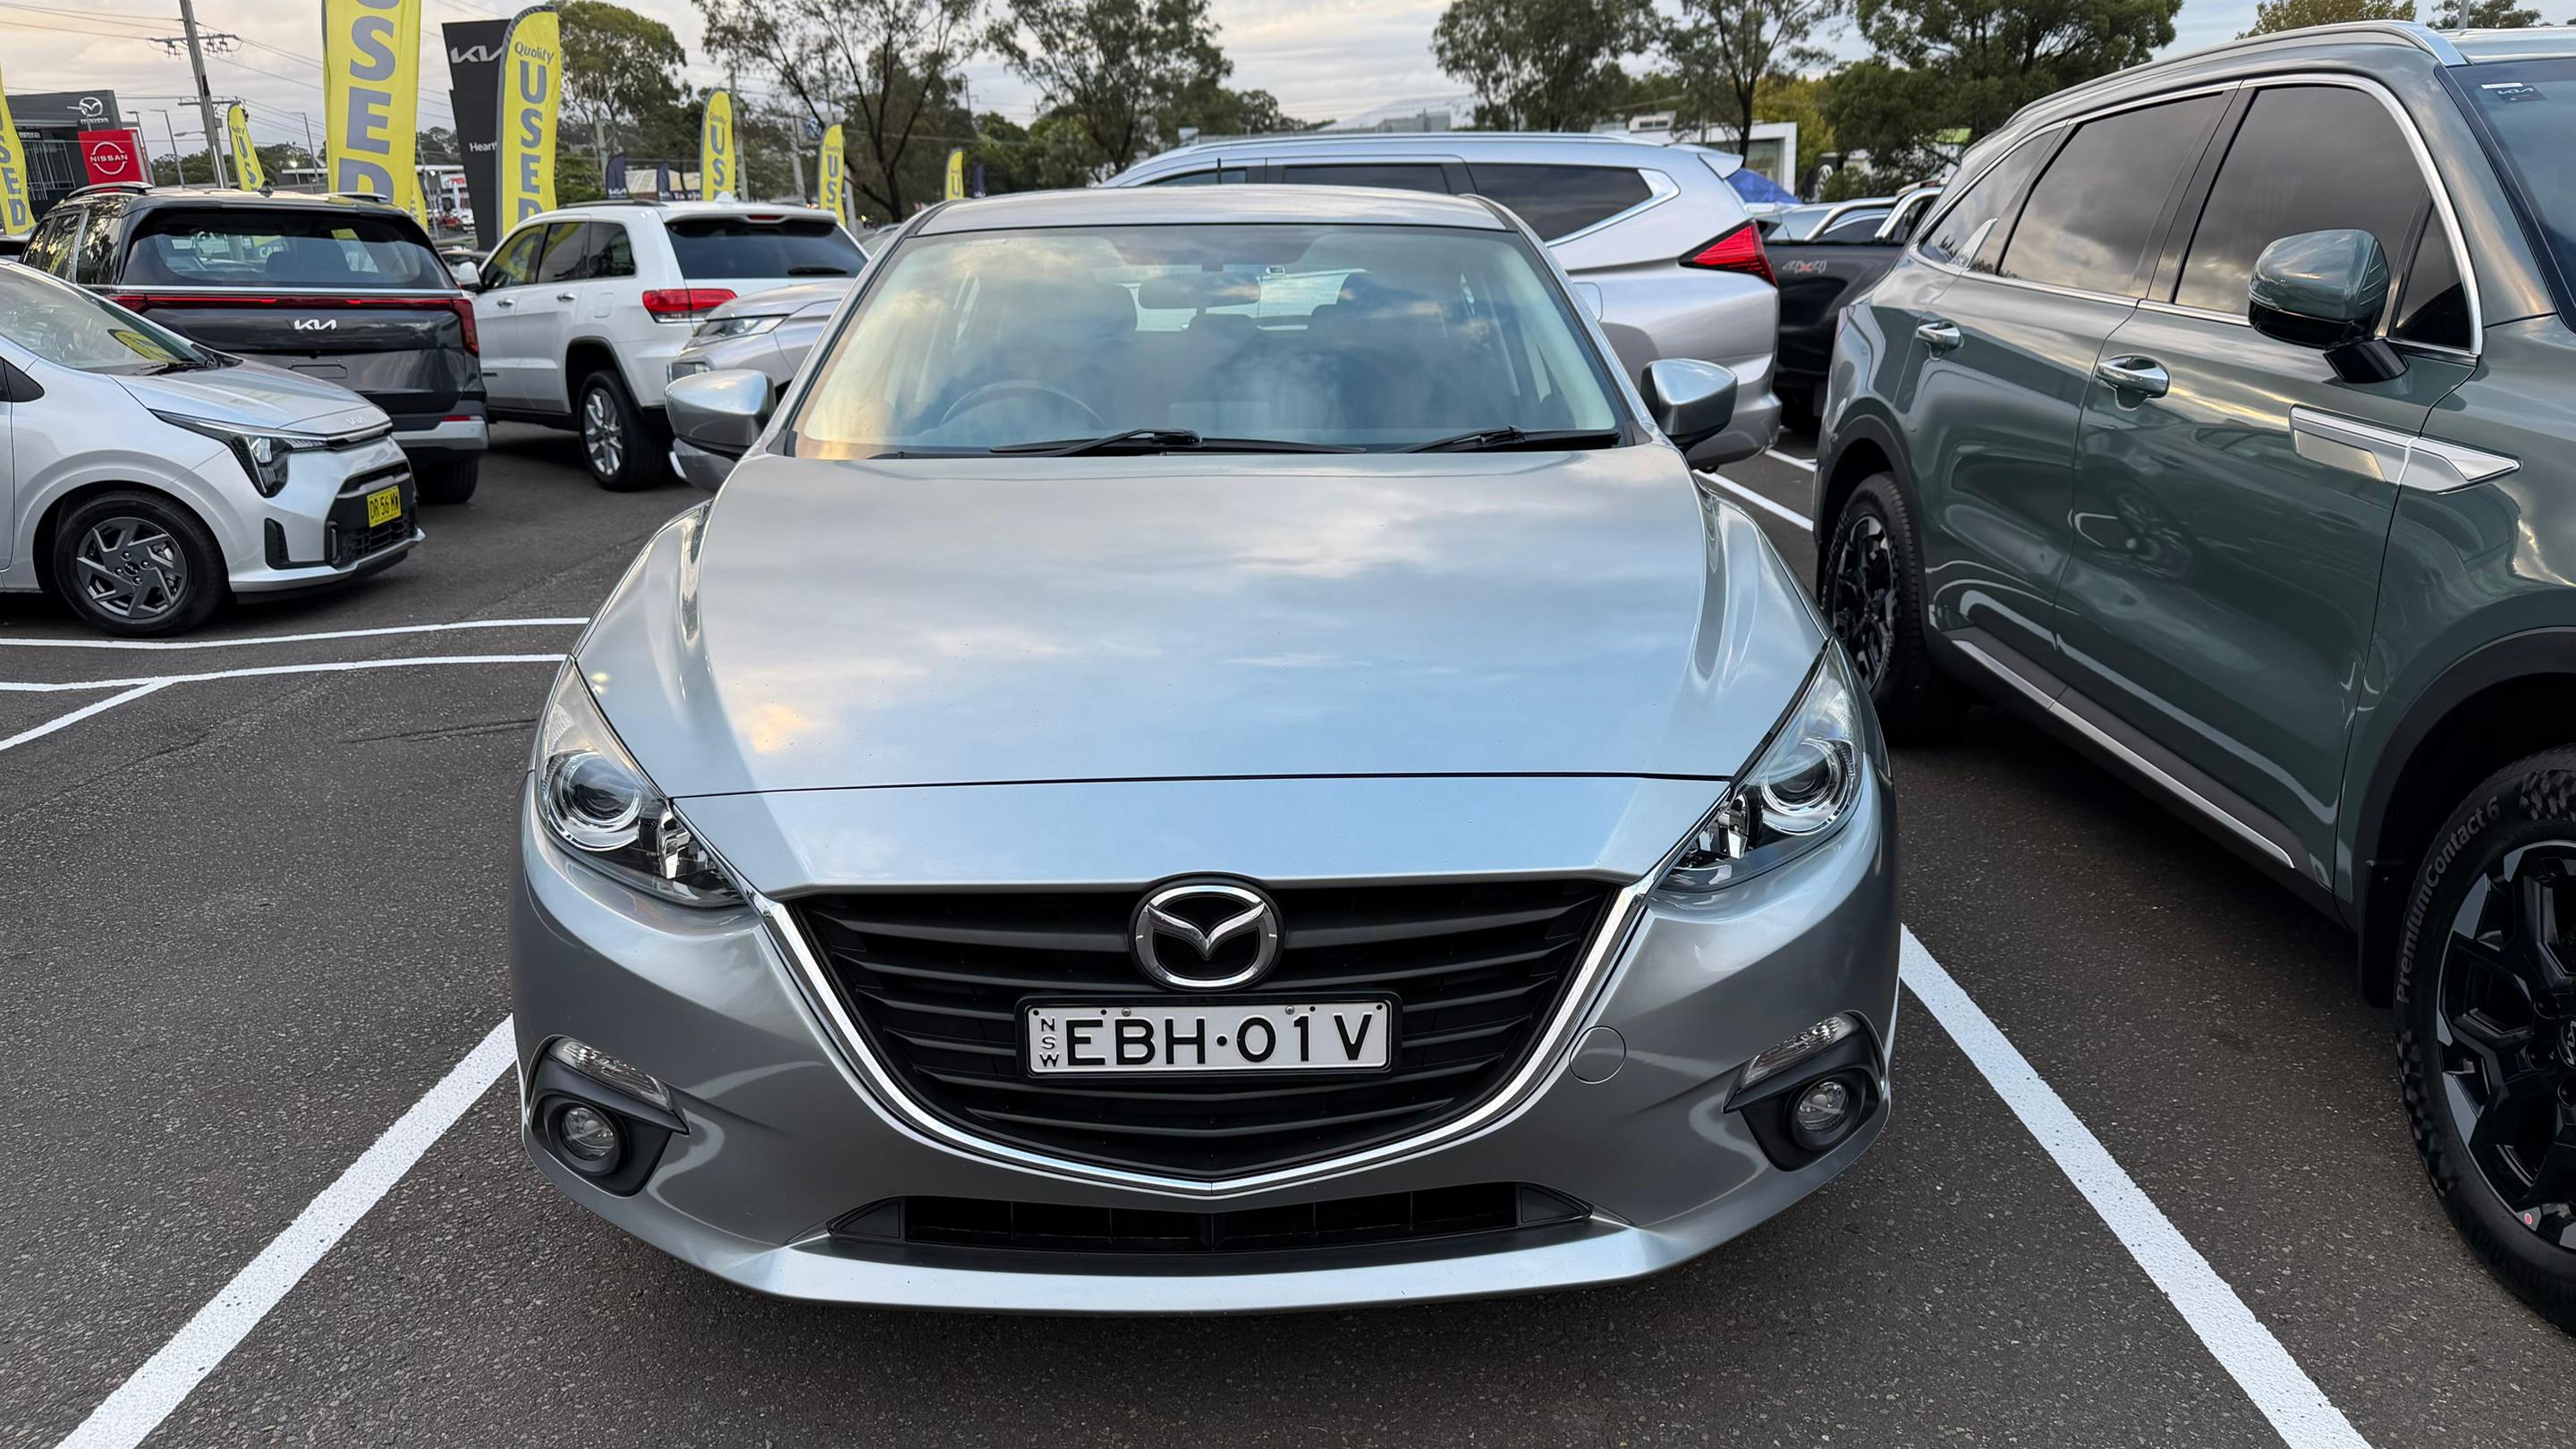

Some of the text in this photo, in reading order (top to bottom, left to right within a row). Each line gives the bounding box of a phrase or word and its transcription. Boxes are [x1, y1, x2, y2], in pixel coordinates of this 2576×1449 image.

[514, 41, 554, 64] Quality
[338, 0, 396, 204] SED
[470, 141, 497, 153] Heart
[0, 109, 26, 226] SED
[90, 154, 128, 163] NISSAN
[293, 318, 337, 330] KIA
[380, 495, 390, 515] 56
[1039, 1018, 1060, 1067] NSW
